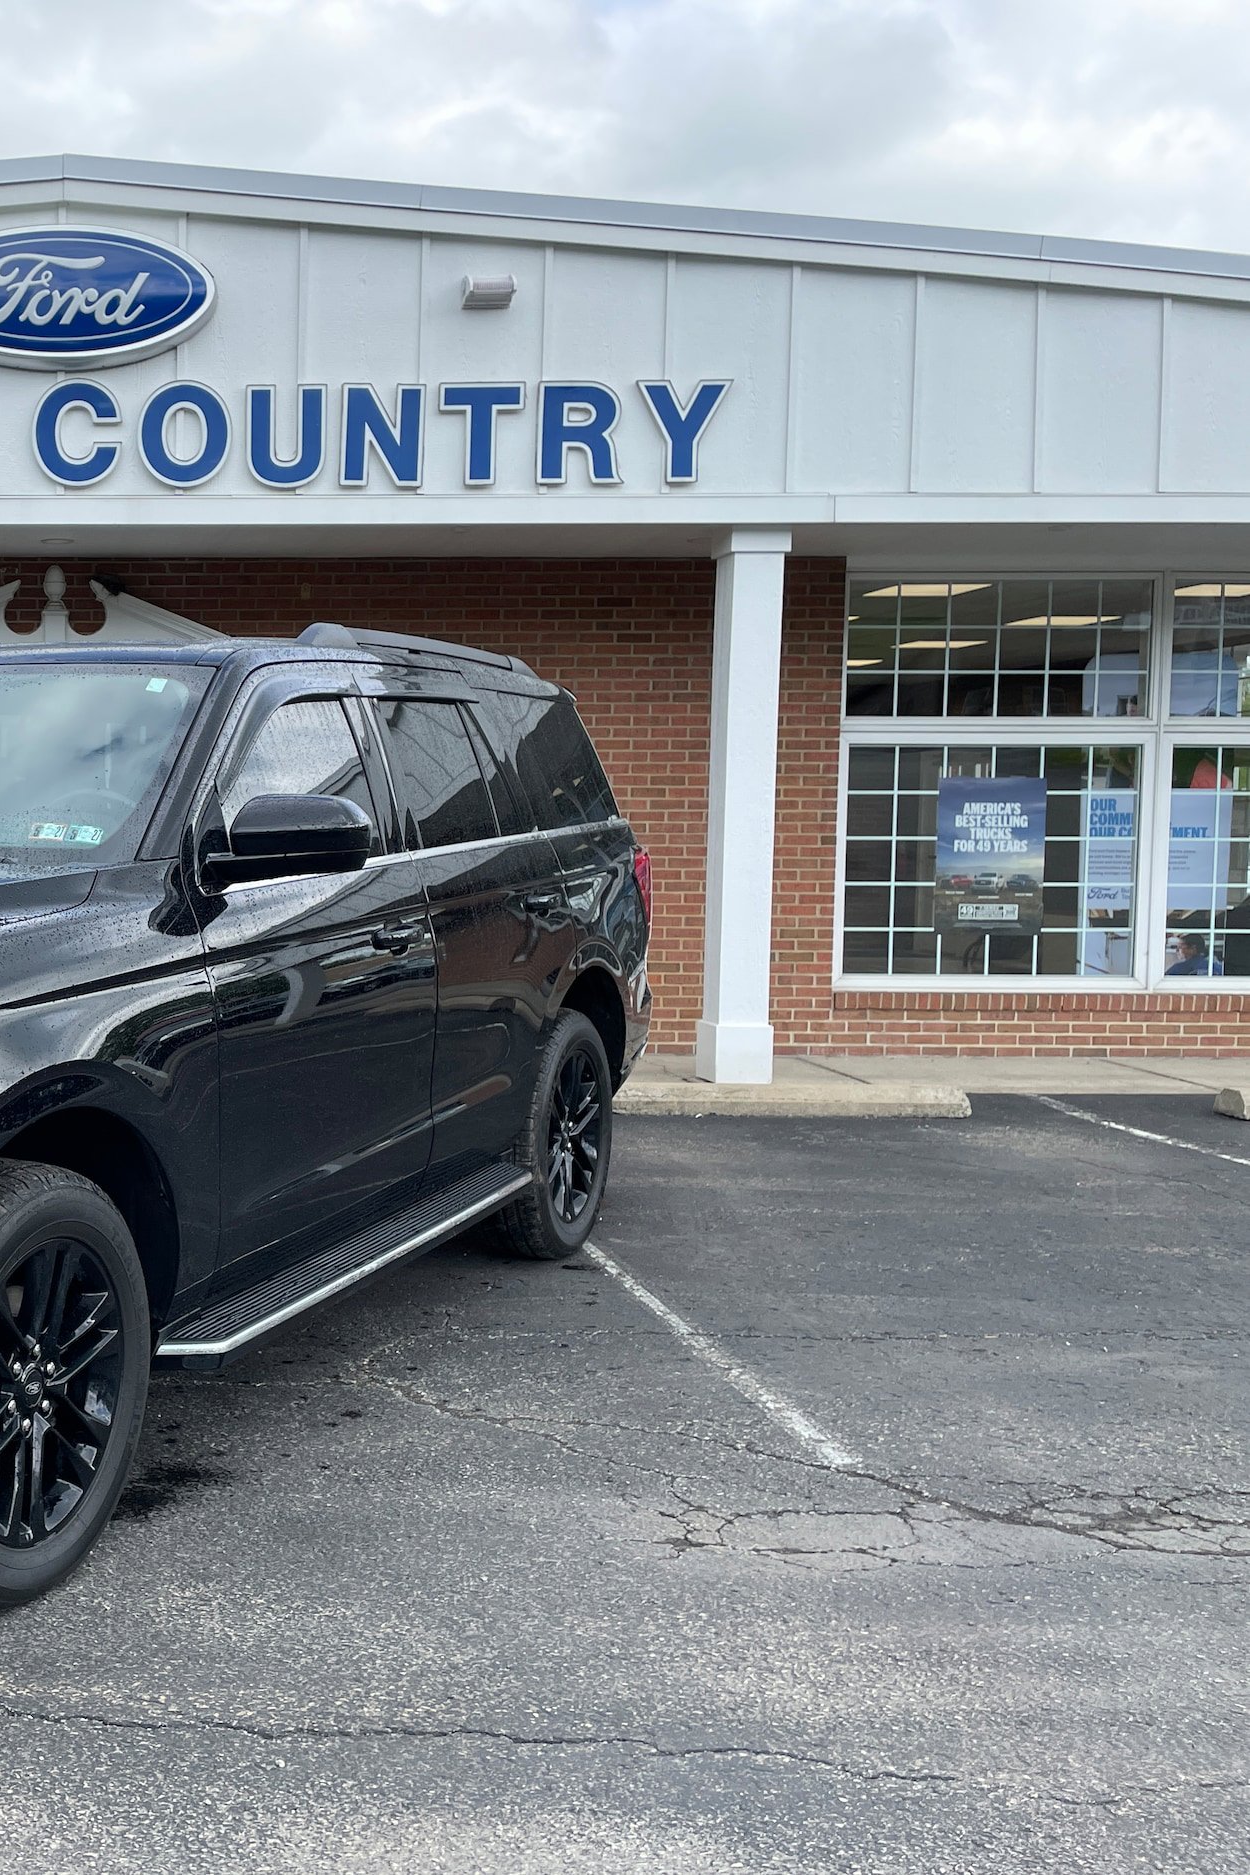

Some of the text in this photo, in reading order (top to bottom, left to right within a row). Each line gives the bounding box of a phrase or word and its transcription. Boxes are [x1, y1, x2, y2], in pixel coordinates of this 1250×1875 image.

[33, 378, 733, 490] COUNTRY
[962, 802, 1021, 815] AMERICA'S
[1090, 798, 1117, 811] OUR
[955, 815, 1028, 828] BEST-SELLING
[970, 828, 1012, 840] TRUCKS
[954, 840, 1028, 853] FOR 49 YEARS
